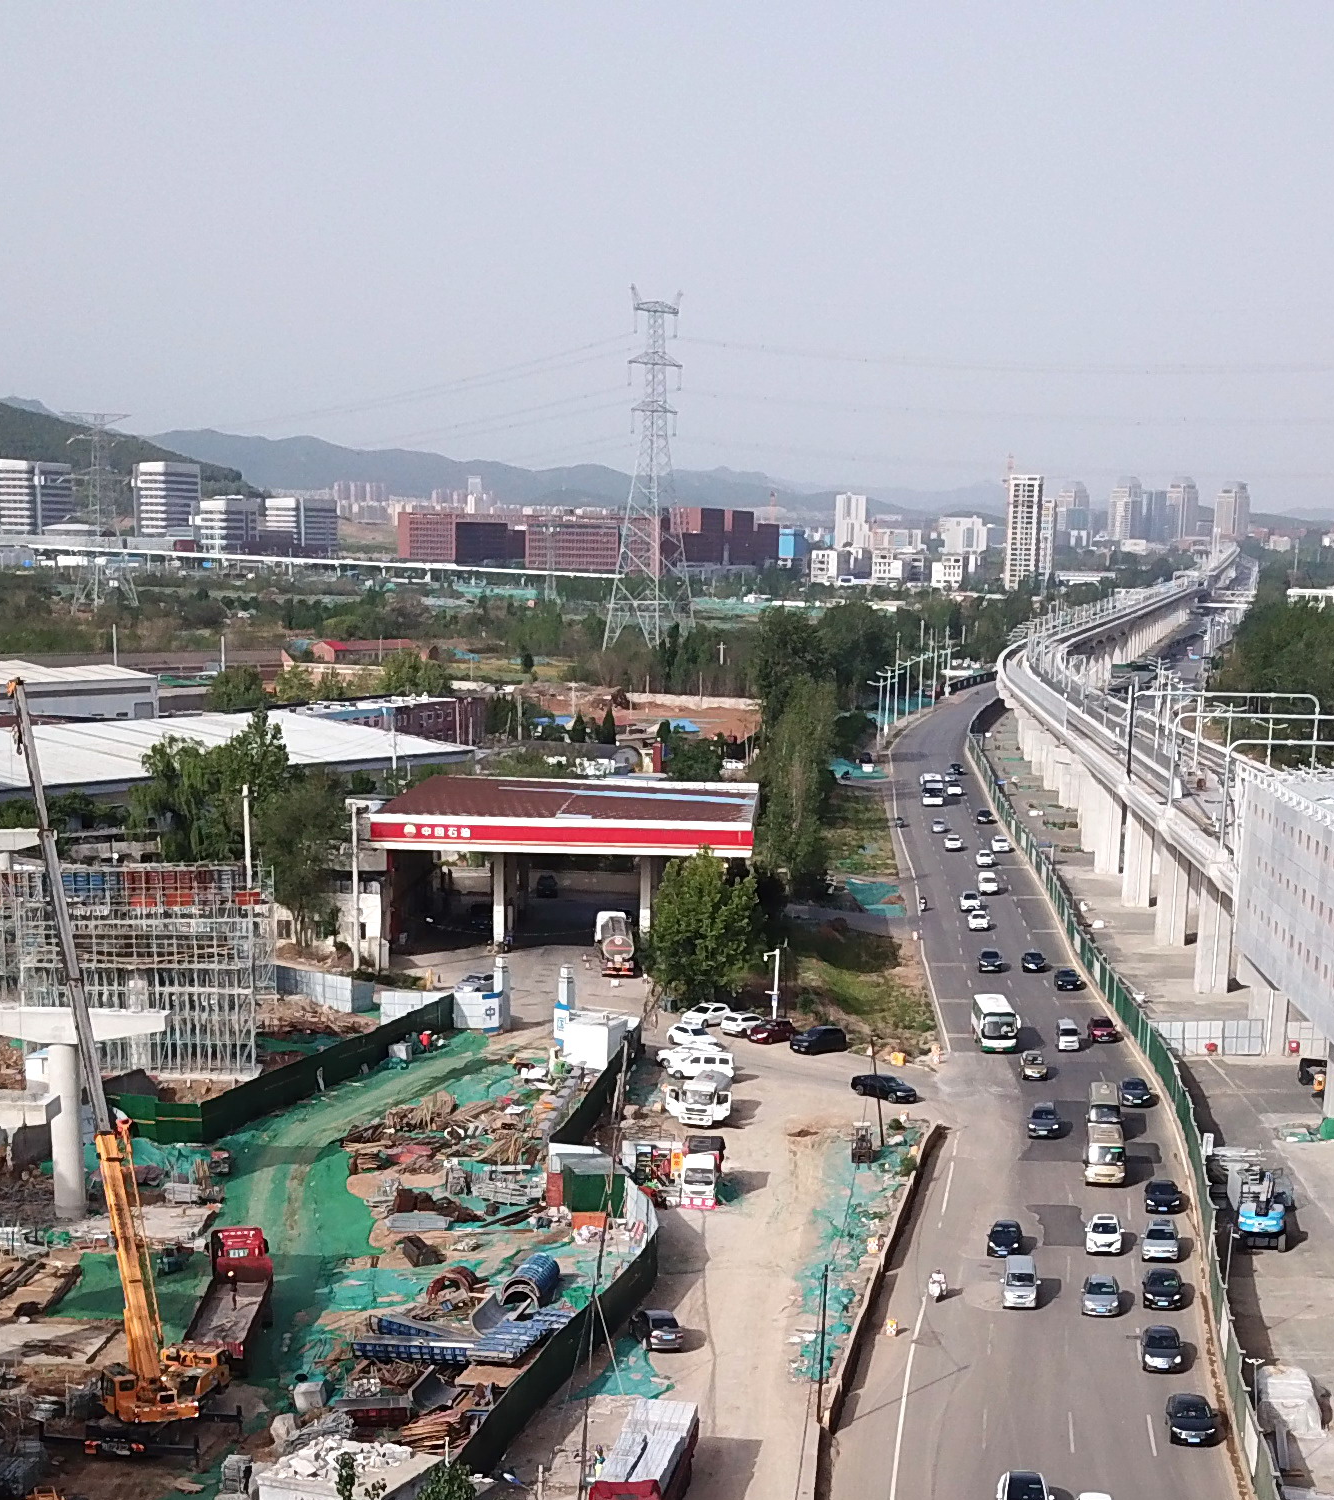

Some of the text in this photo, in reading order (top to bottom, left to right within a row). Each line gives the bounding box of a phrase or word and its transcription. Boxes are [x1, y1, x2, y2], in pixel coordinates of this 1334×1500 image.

[421, 826, 471, 838] 中国石油
[484, 1005, 496, 1021] 中
